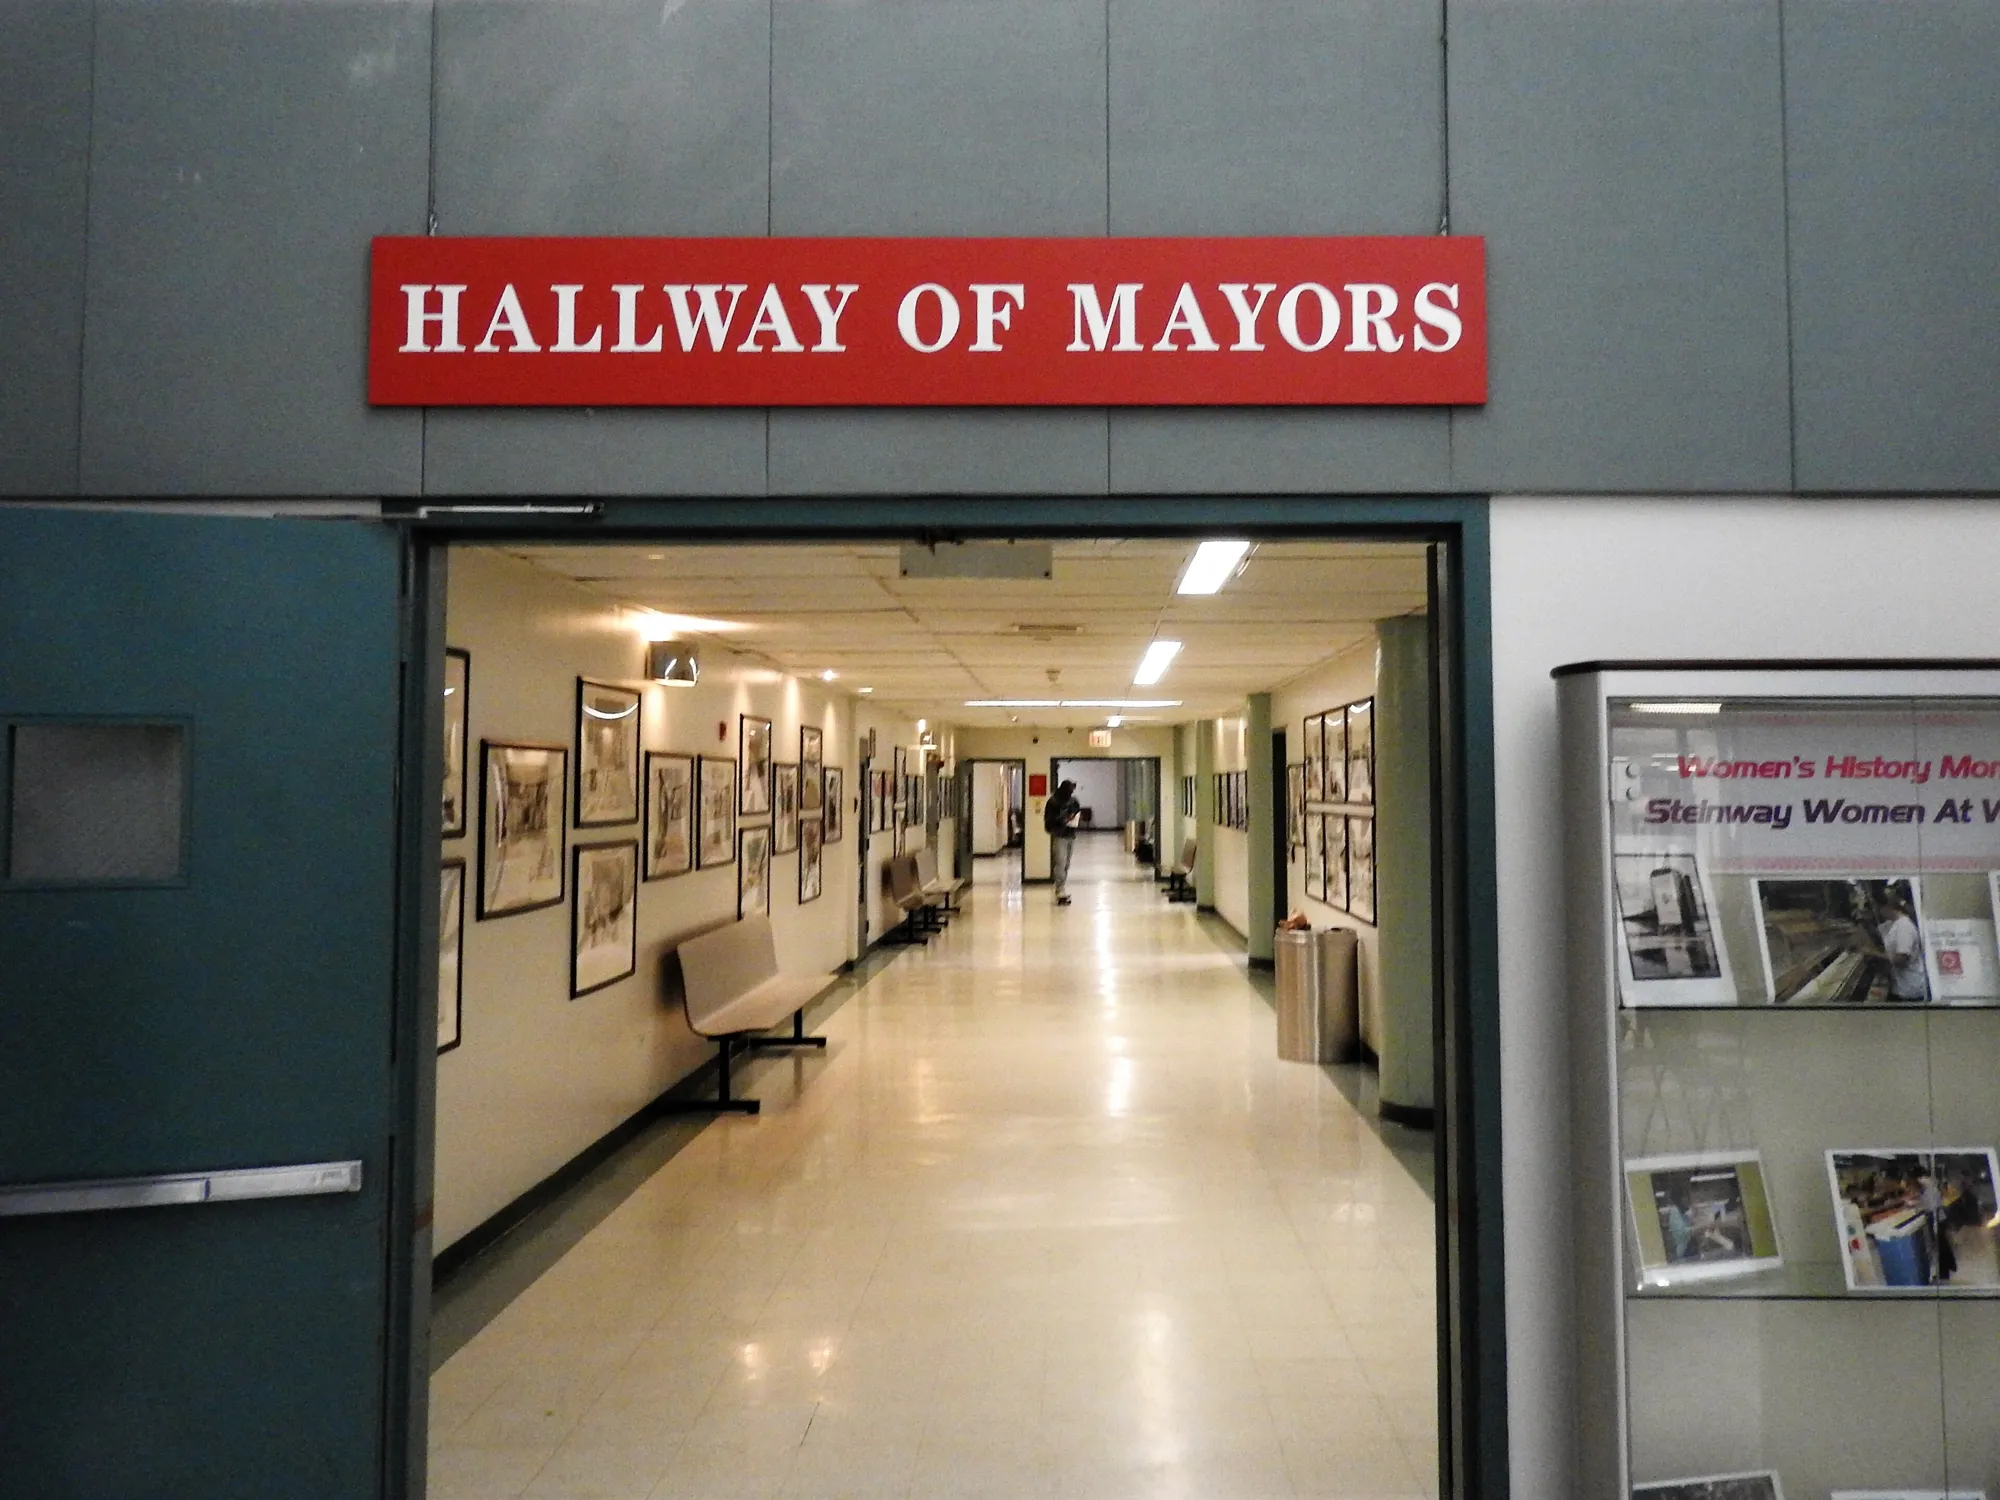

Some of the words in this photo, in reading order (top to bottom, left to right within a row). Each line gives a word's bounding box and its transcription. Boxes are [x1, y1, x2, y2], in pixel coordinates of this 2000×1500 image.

[399, 283, 860, 354] HALLWAY
[896, 282, 1026, 354] OF
[1065, 281, 1463, 354] MAYORS
[1677, 755, 1815, 779] Women's
[1824, 755, 1931, 784] History
[1644, 798, 1792, 829] Steinway
[1803, 798, 1925, 824] Women
[1932, 798, 1973, 824] At
